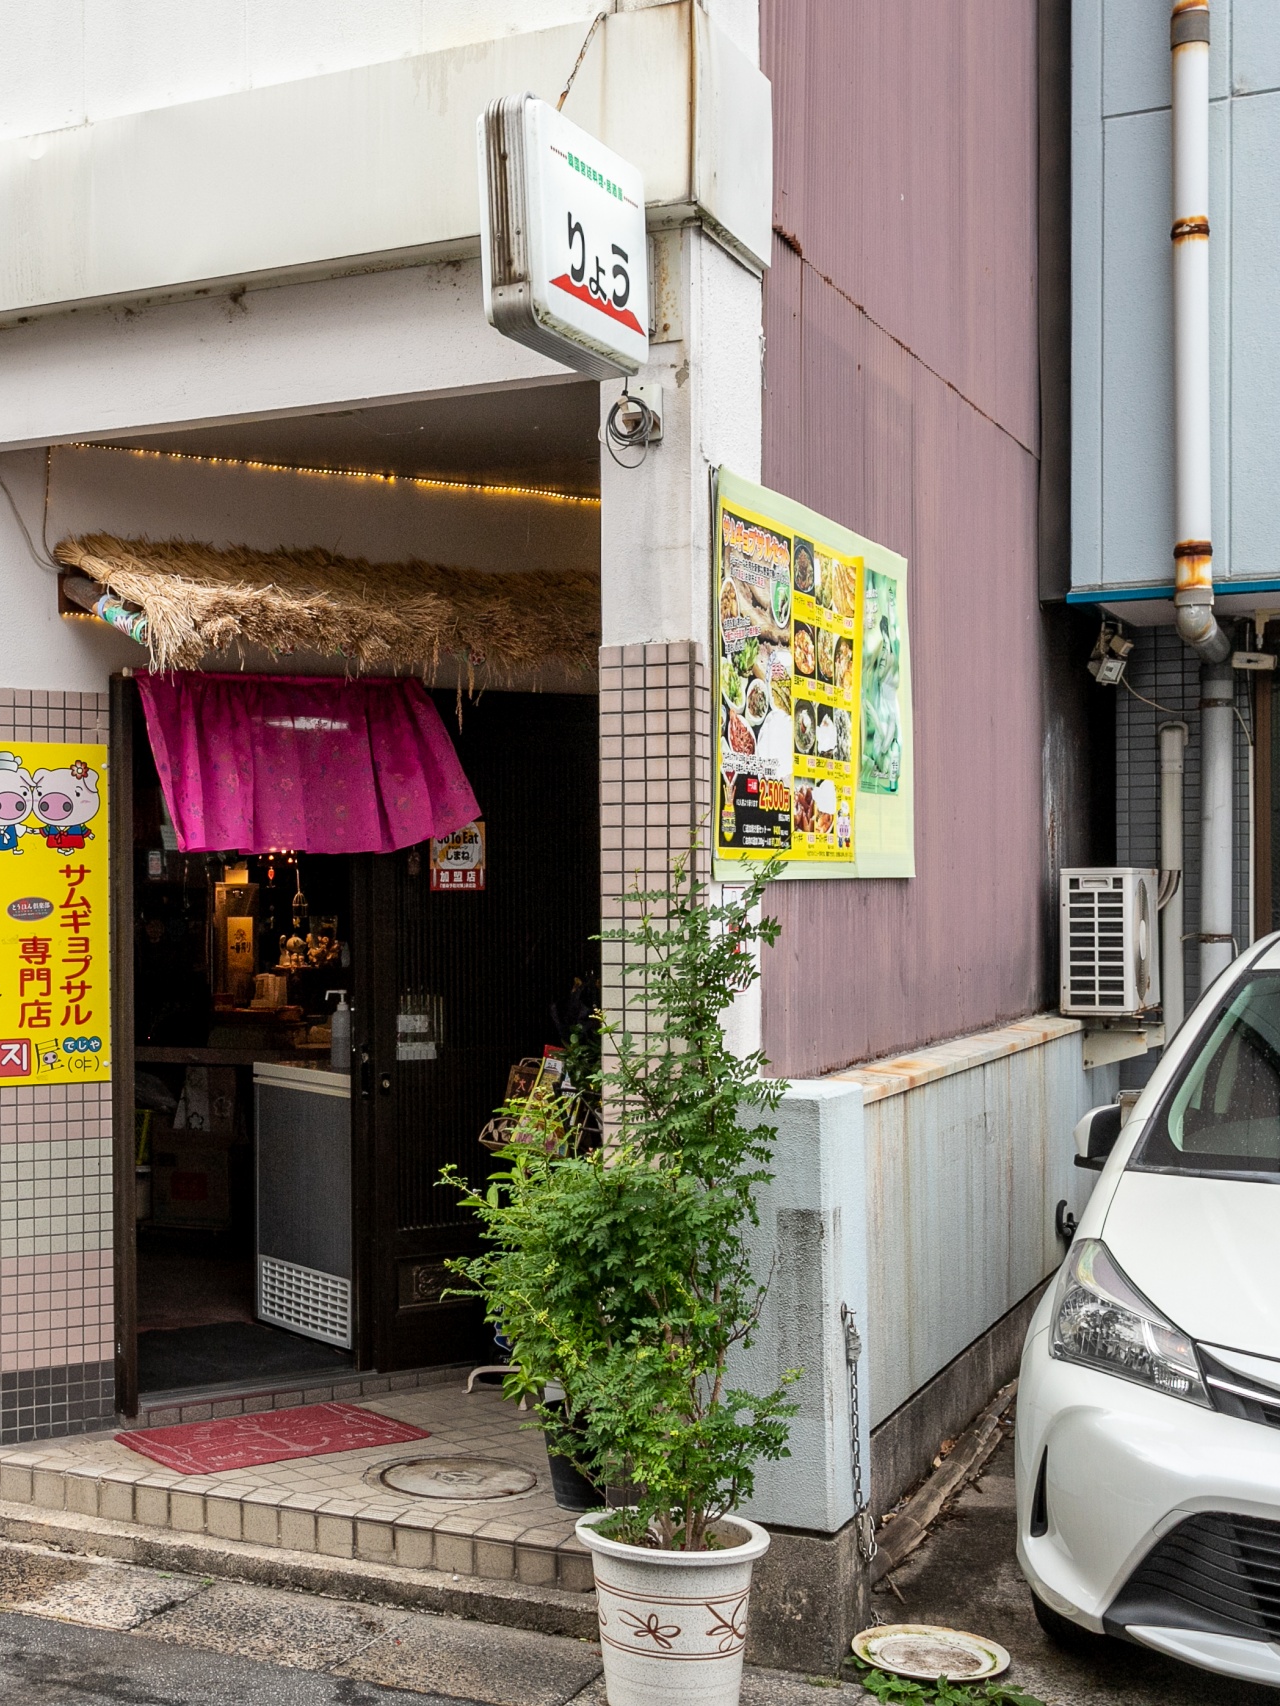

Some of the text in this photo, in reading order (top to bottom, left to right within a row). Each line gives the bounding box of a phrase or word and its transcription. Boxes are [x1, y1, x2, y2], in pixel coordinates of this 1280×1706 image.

[567, 211, 631, 308] りょう
[759, 778, 790, 812] 2,500円
[450, 831, 461, 844] To
[463, 831, 479, 844] Eat
[446, 850, 470, 861] しまね
[440, 871, 476, 882] 加盟店
[58, 864, 93, 1027] サムギョプサル
[17, 936, 52, 1029] 専門店
[64, 1039, 101, 1051] でじや
